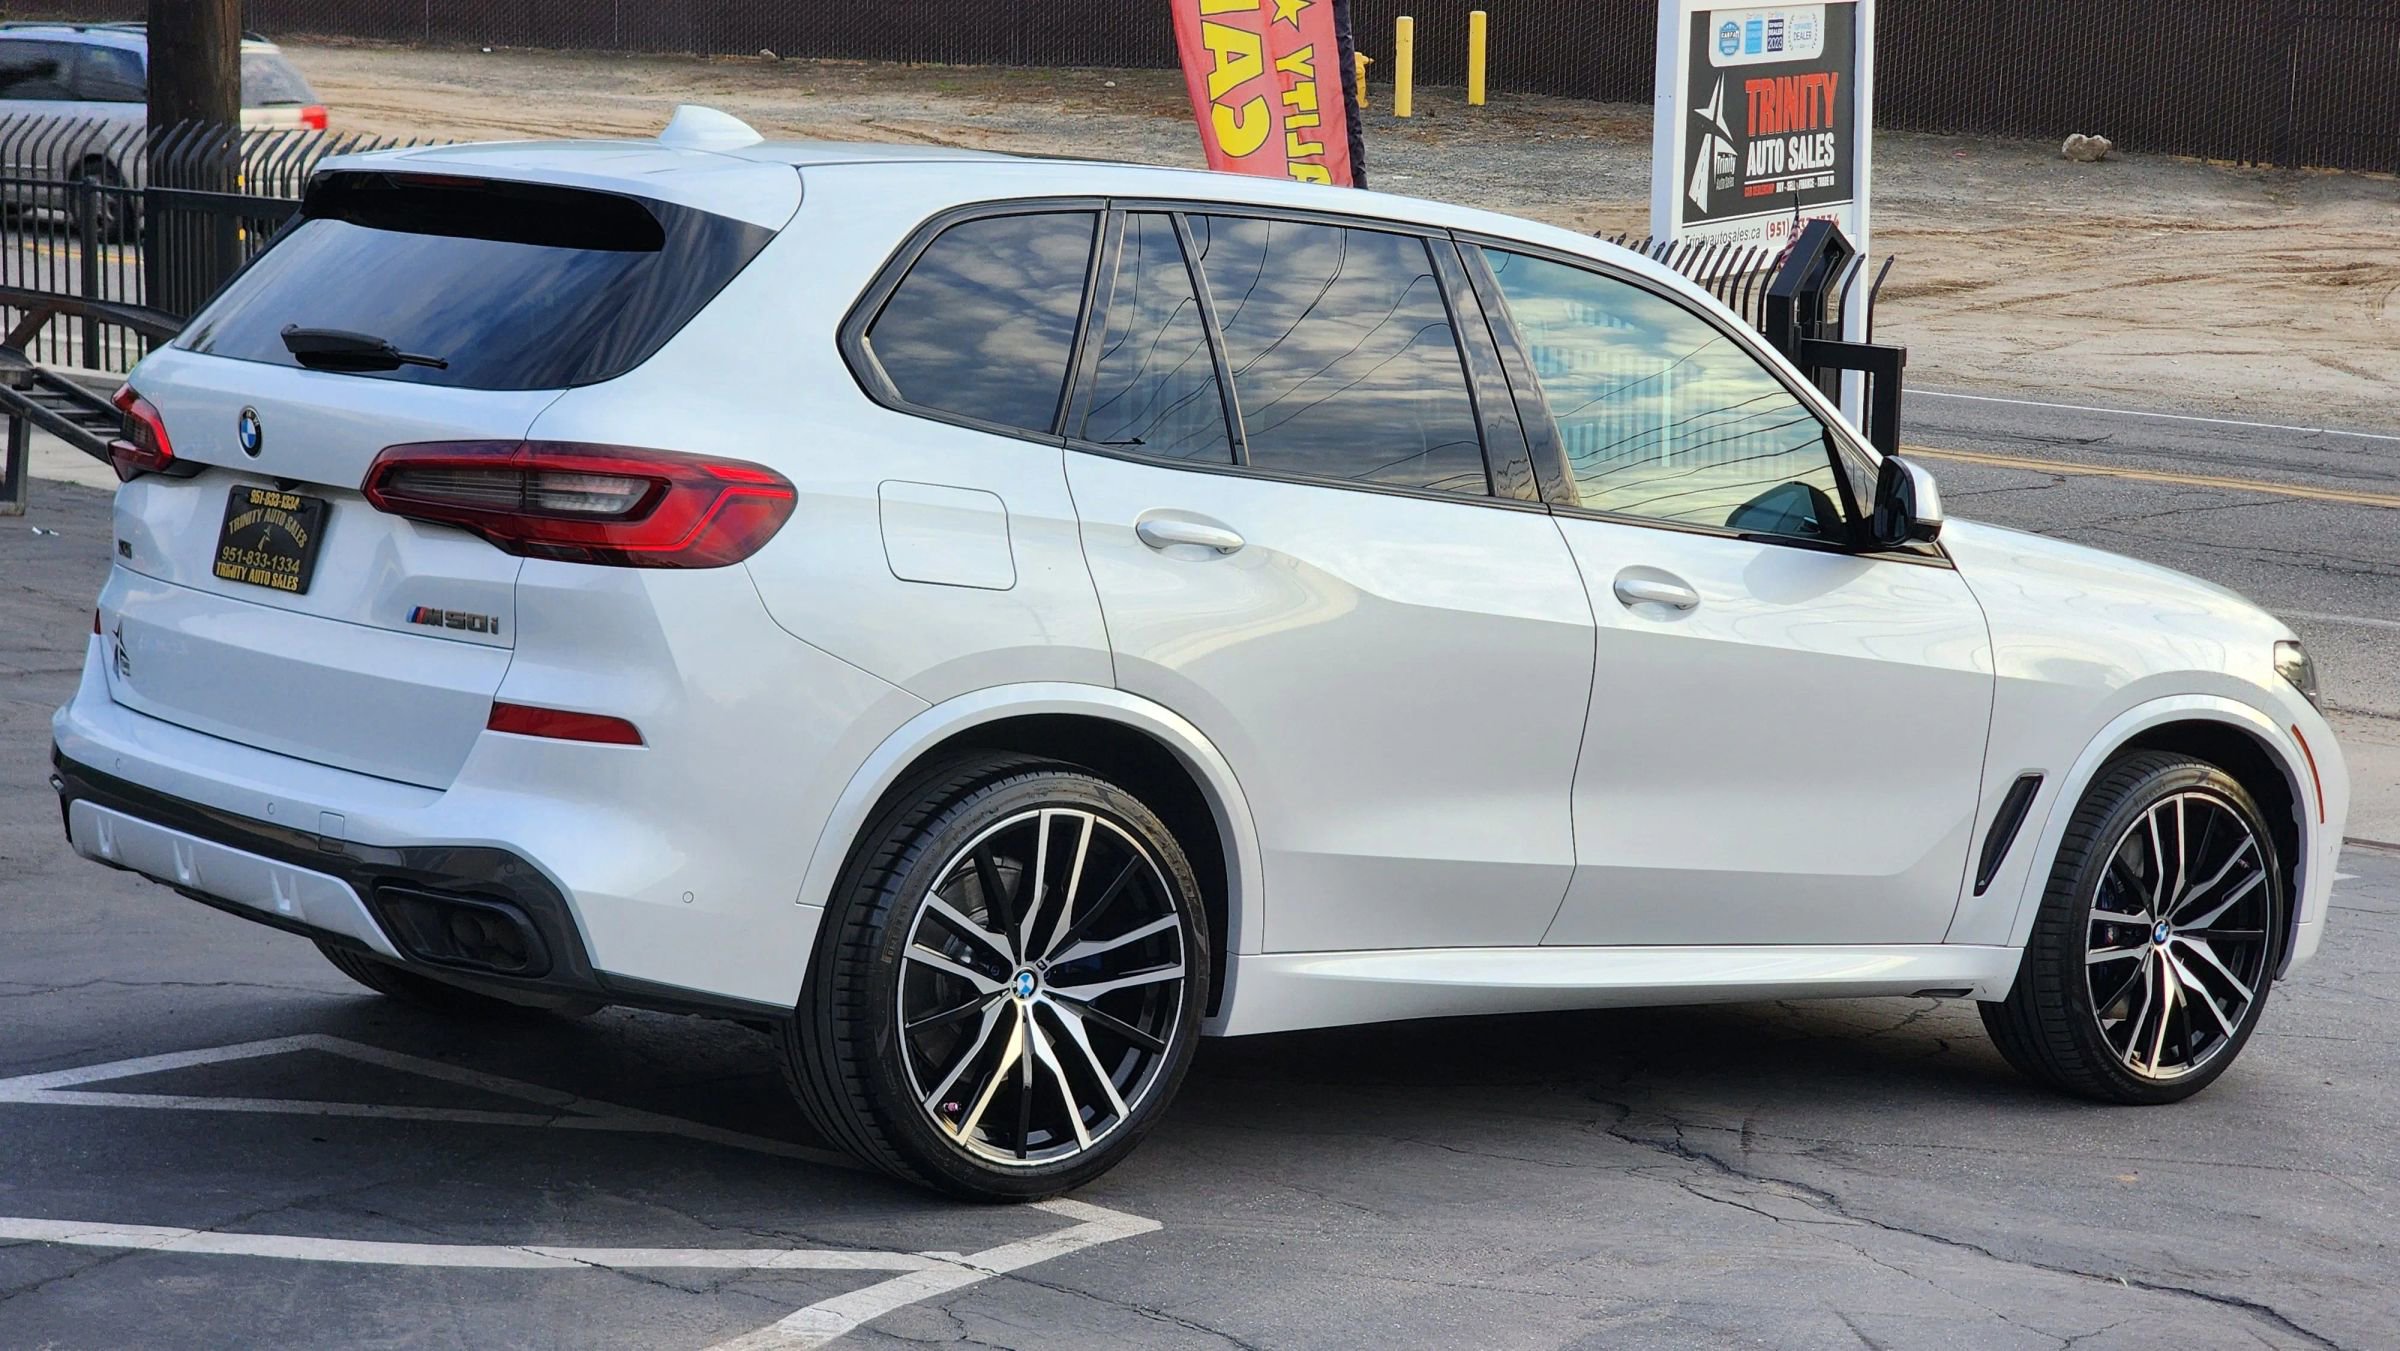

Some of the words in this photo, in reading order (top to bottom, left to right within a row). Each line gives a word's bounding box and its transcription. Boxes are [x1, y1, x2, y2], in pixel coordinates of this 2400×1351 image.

[1793, 31, 1812, 41] DEALER
[1744, 72, 1839, 137] TRINITY
[1717, 154, 1736, 175] Trinity
[1746, 138, 1784, 177] AUTO
[1788, 132, 1835, 172] SALES
[1766, 218, 1790, 240] (951)
[249, 489, 301, 511] 951-833-1334
[228, 508, 264, 535] TRINITY
[263, 508, 287, 527] AUTO
[284, 516, 308, 549] SALES
[221, 546, 300, 574] 951-833-1334
[216, 561, 248, 581] TRINITY
[248, 568, 271, 586] AUTO
[271, 573, 299, 591] SALES
